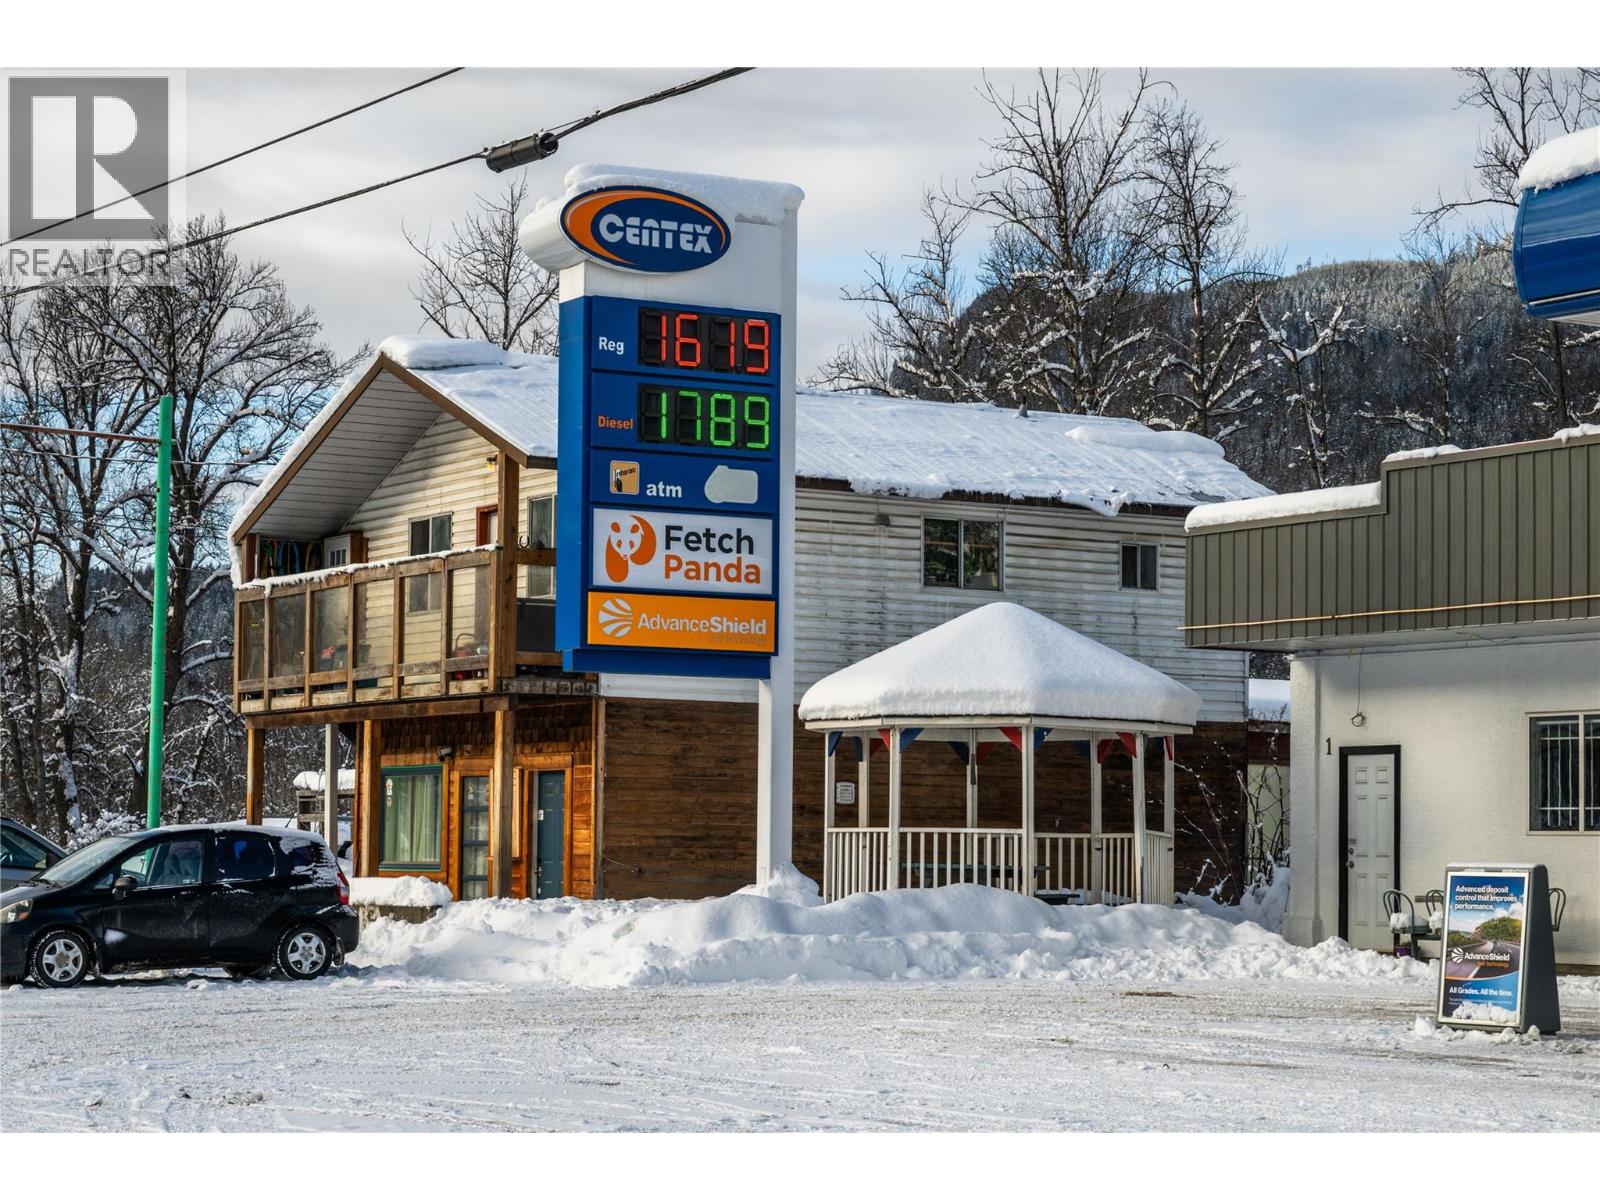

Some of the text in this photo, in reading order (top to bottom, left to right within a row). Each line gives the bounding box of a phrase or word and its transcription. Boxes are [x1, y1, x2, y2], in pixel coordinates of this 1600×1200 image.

[599, 213, 712, 254] CENTEX
[599, 337, 625, 355] Reg
[598, 416, 634, 430] Diesel
[646, 481, 683, 498] atm
[665, 525, 754, 555] Fetch
[664, 554, 761, 584] Panda
[637, 613, 767, 635] AdvanceShield
[1326, 737, 1332, 755] 1
[1455, 885, 1509, 894] Advanced deposit
[1454, 903, 1495, 911] performance.
[1490, 895, 1517, 903] improves
[1464, 952, 1510, 961] AdvanceShield
[1449, 986, 1457, 994] All
[1458, 987, 1480, 995] Grades.
[1489, 988, 1498, 996] the
